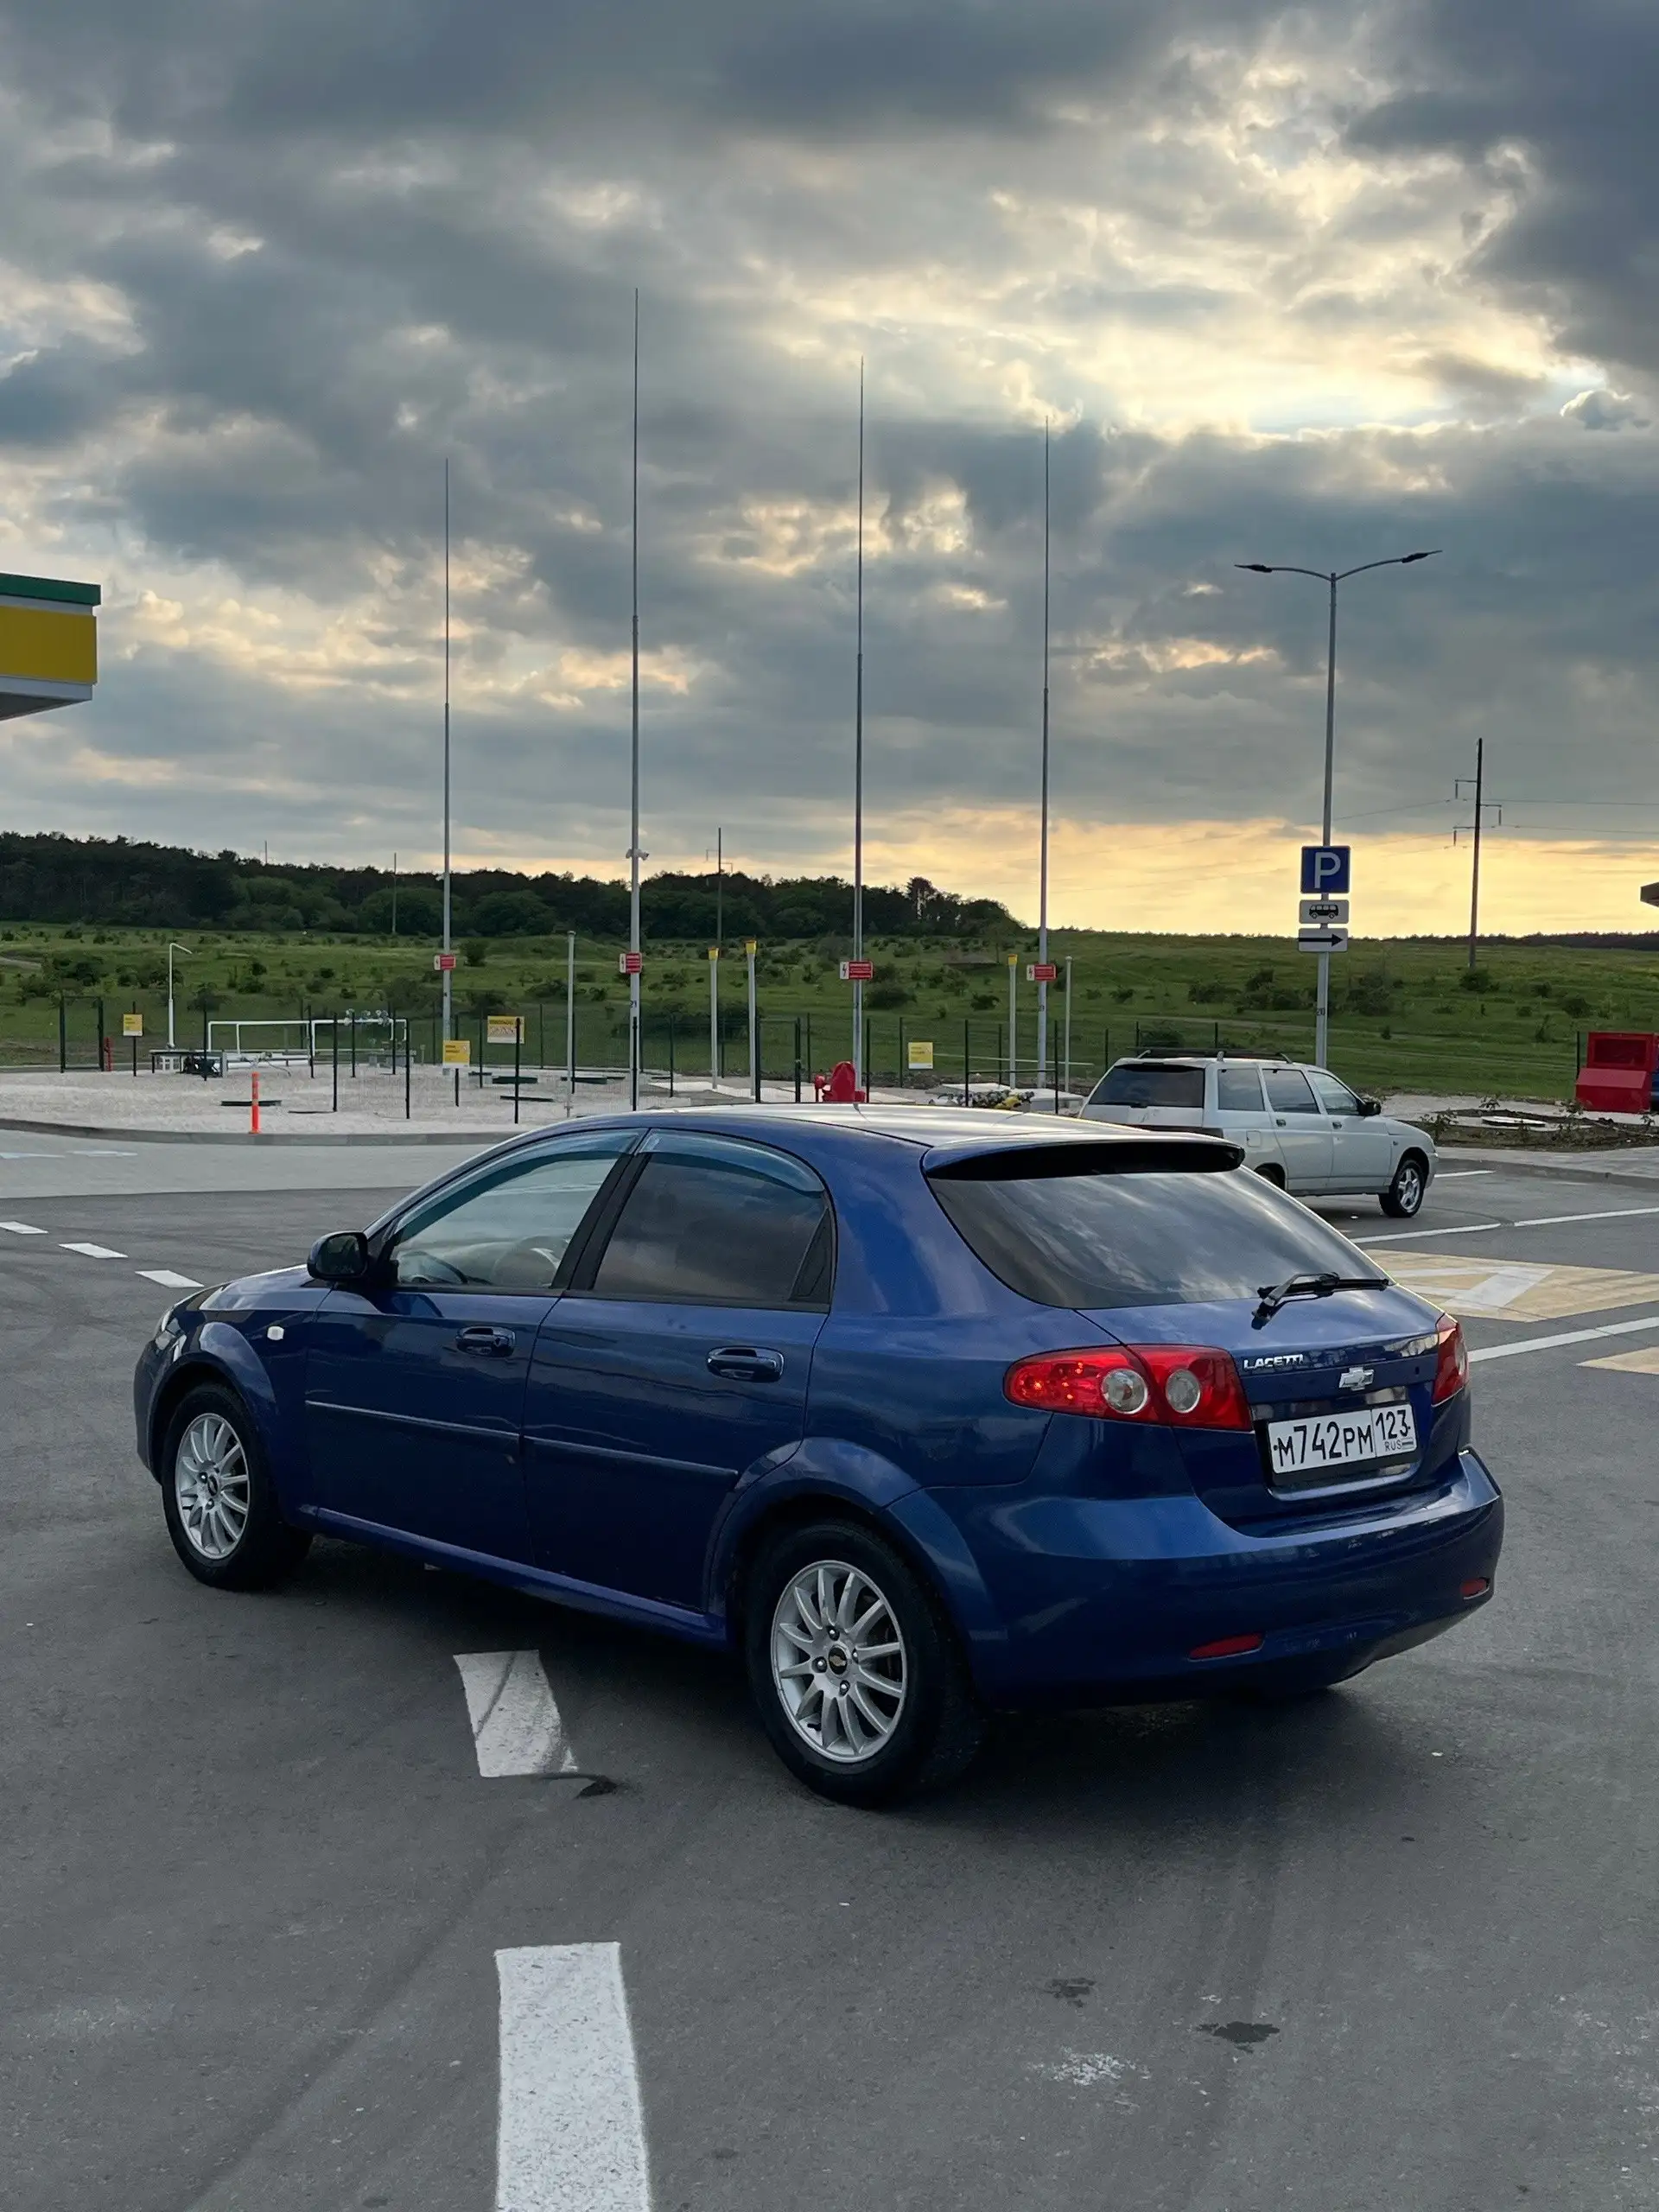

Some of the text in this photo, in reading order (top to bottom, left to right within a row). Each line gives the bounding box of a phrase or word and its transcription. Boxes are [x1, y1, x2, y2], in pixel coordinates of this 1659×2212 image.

[1313, 852, 1341, 888] P
[1243, 1353, 1304, 1370] LACETTI
[1376, 1409, 1409, 1440] 123
[1384, 1439, 1402, 1452] RUS
